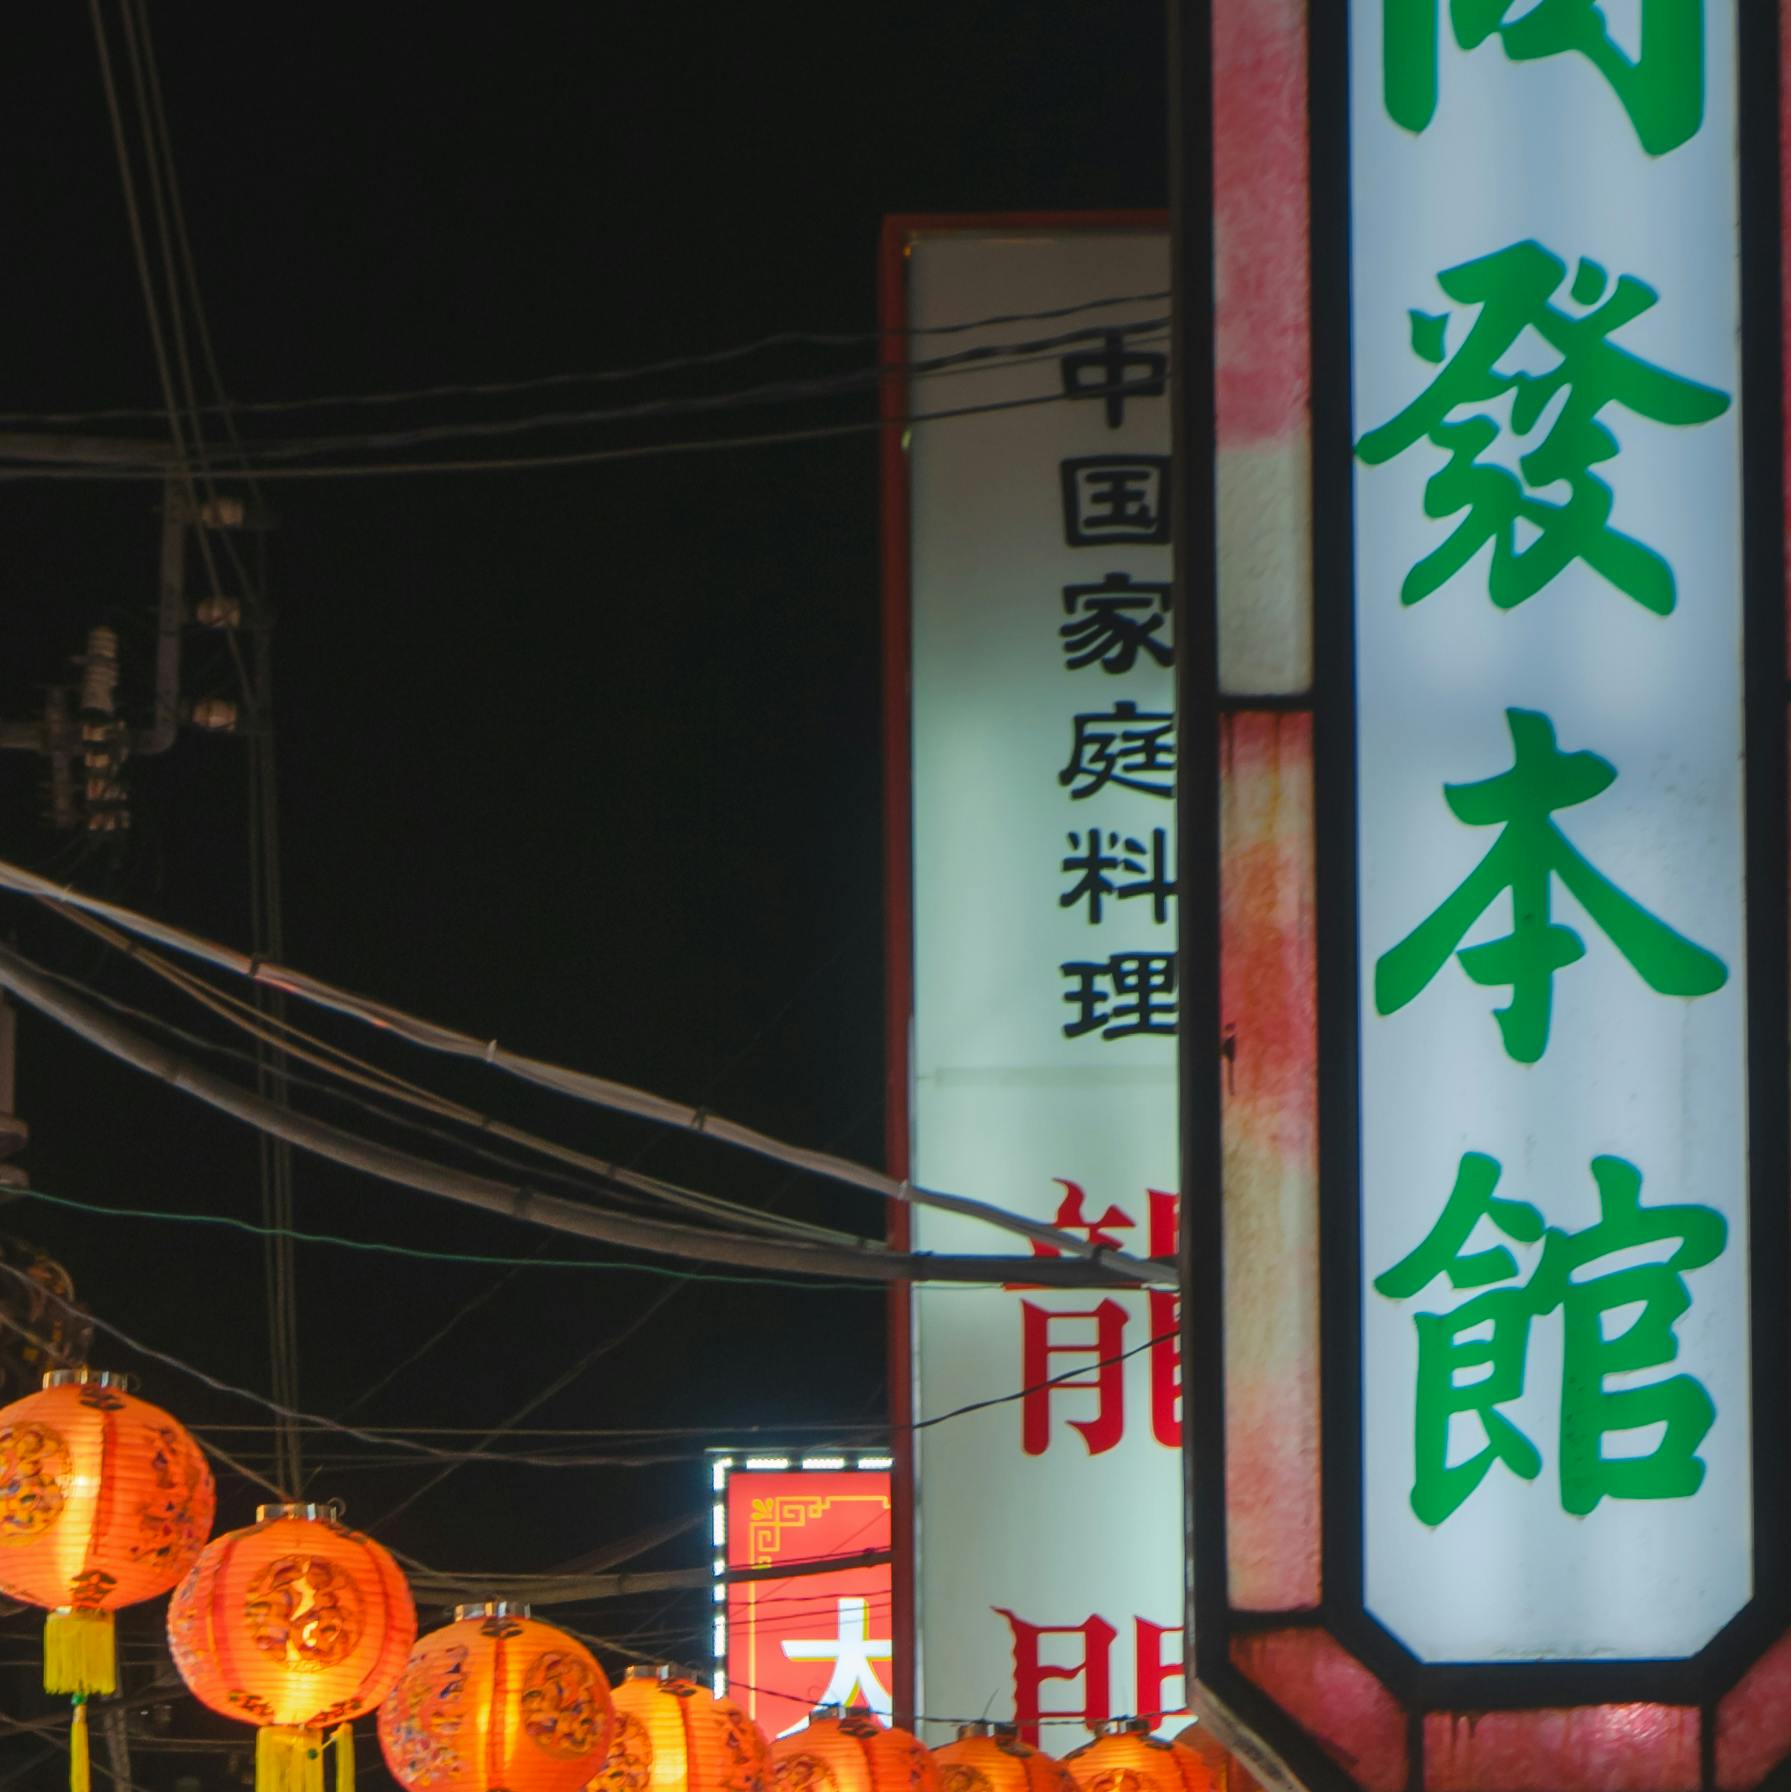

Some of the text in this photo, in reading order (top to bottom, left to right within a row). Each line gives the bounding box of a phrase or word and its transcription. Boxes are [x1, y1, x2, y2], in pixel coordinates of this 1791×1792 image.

[1058, 328, 1176, 1040] 中国家庭料理
